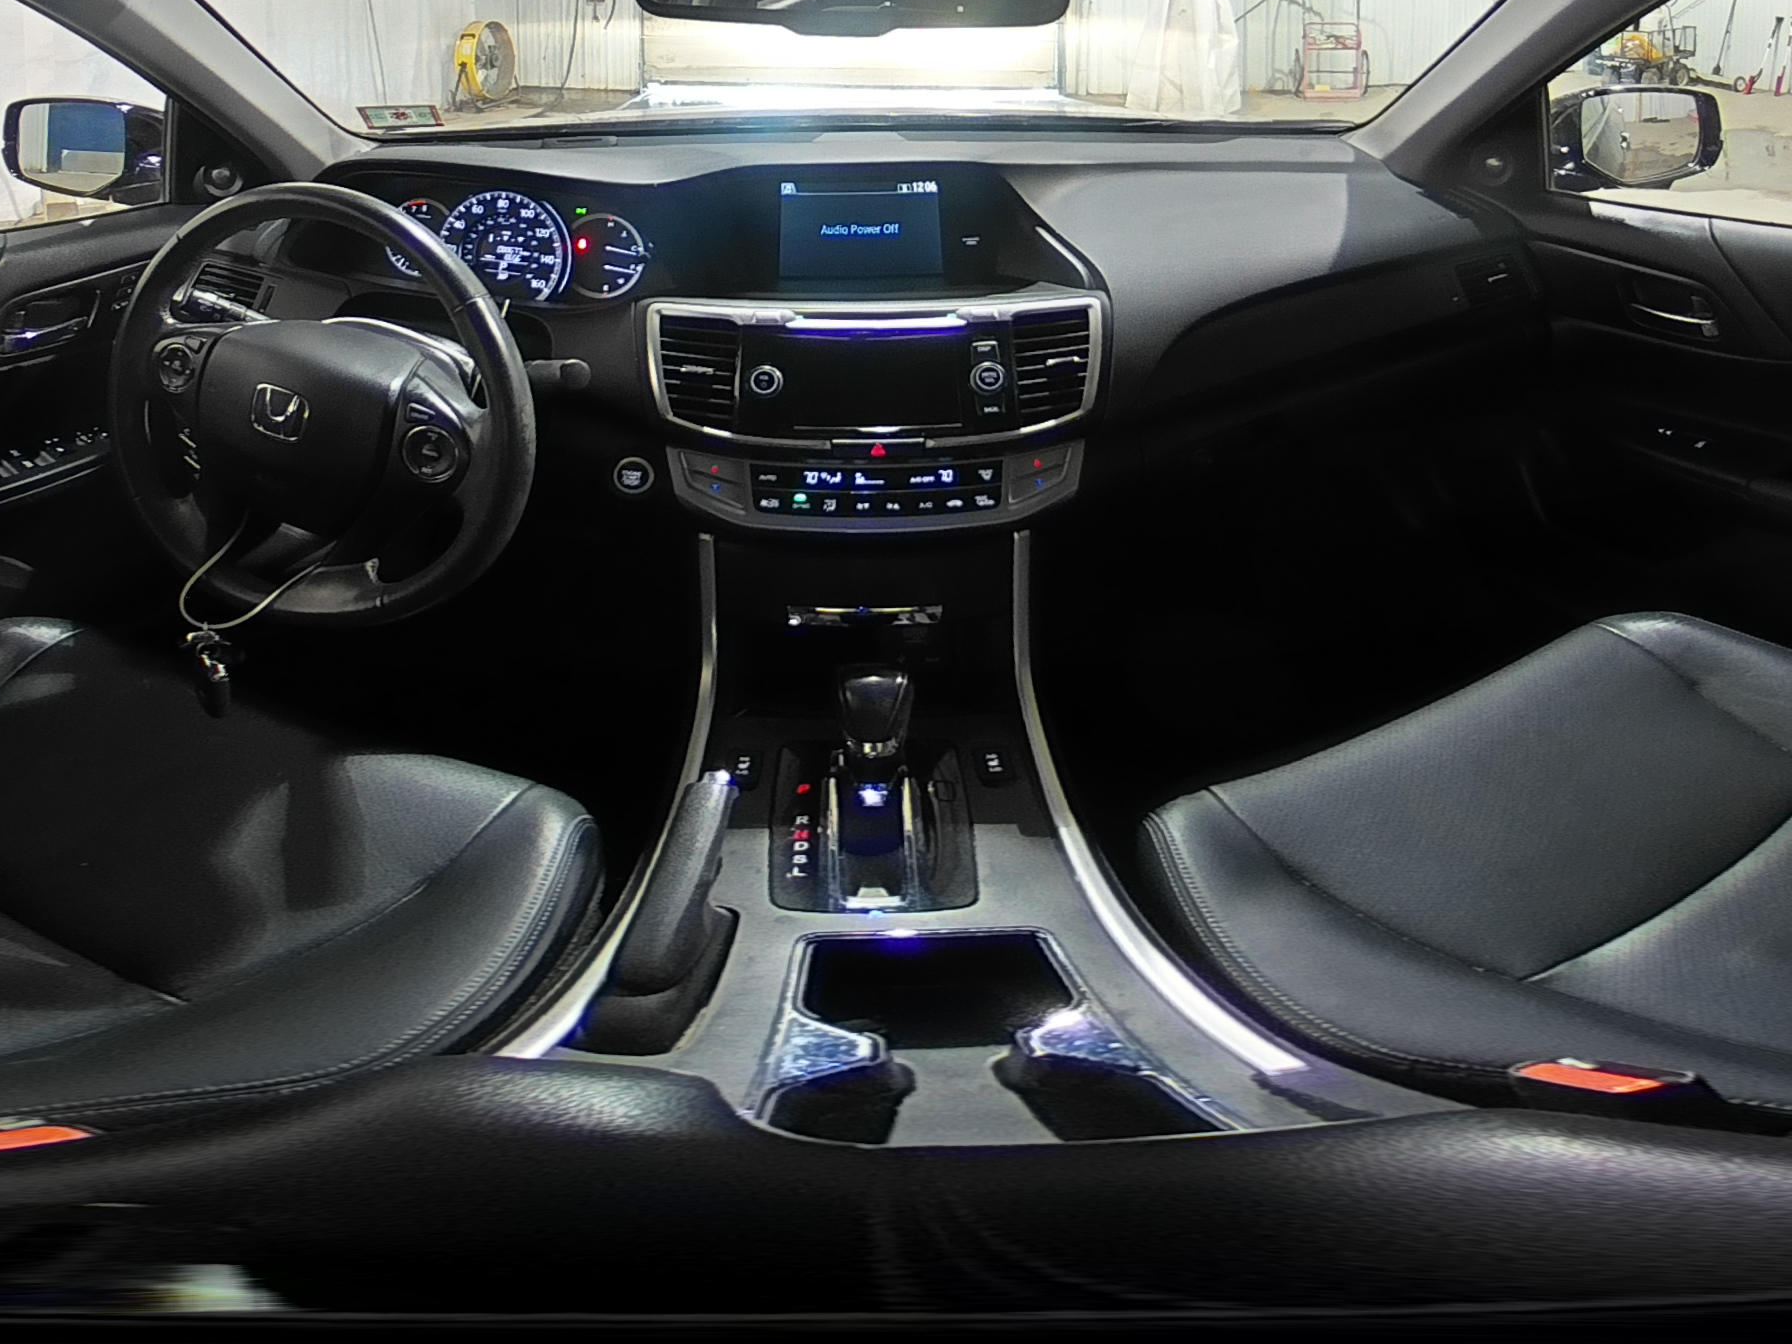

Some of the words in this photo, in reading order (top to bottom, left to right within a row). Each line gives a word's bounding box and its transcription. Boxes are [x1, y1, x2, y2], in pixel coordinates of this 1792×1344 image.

[471, 204, 485, 214] 60
[519, 208, 535, 218] 100
[534, 227, 550, 238] 120
[820, 224, 849, 235] Audio
[850, 224, 882, 235] Power
[883, 223, 899, 234] Off
[540, 254, 555, 265] 140
[530, 278, 547, 289] 160
[794, 815, 810, 825] R
[793, 841, 809, 851] D
[792, 854, 808, 864] S
